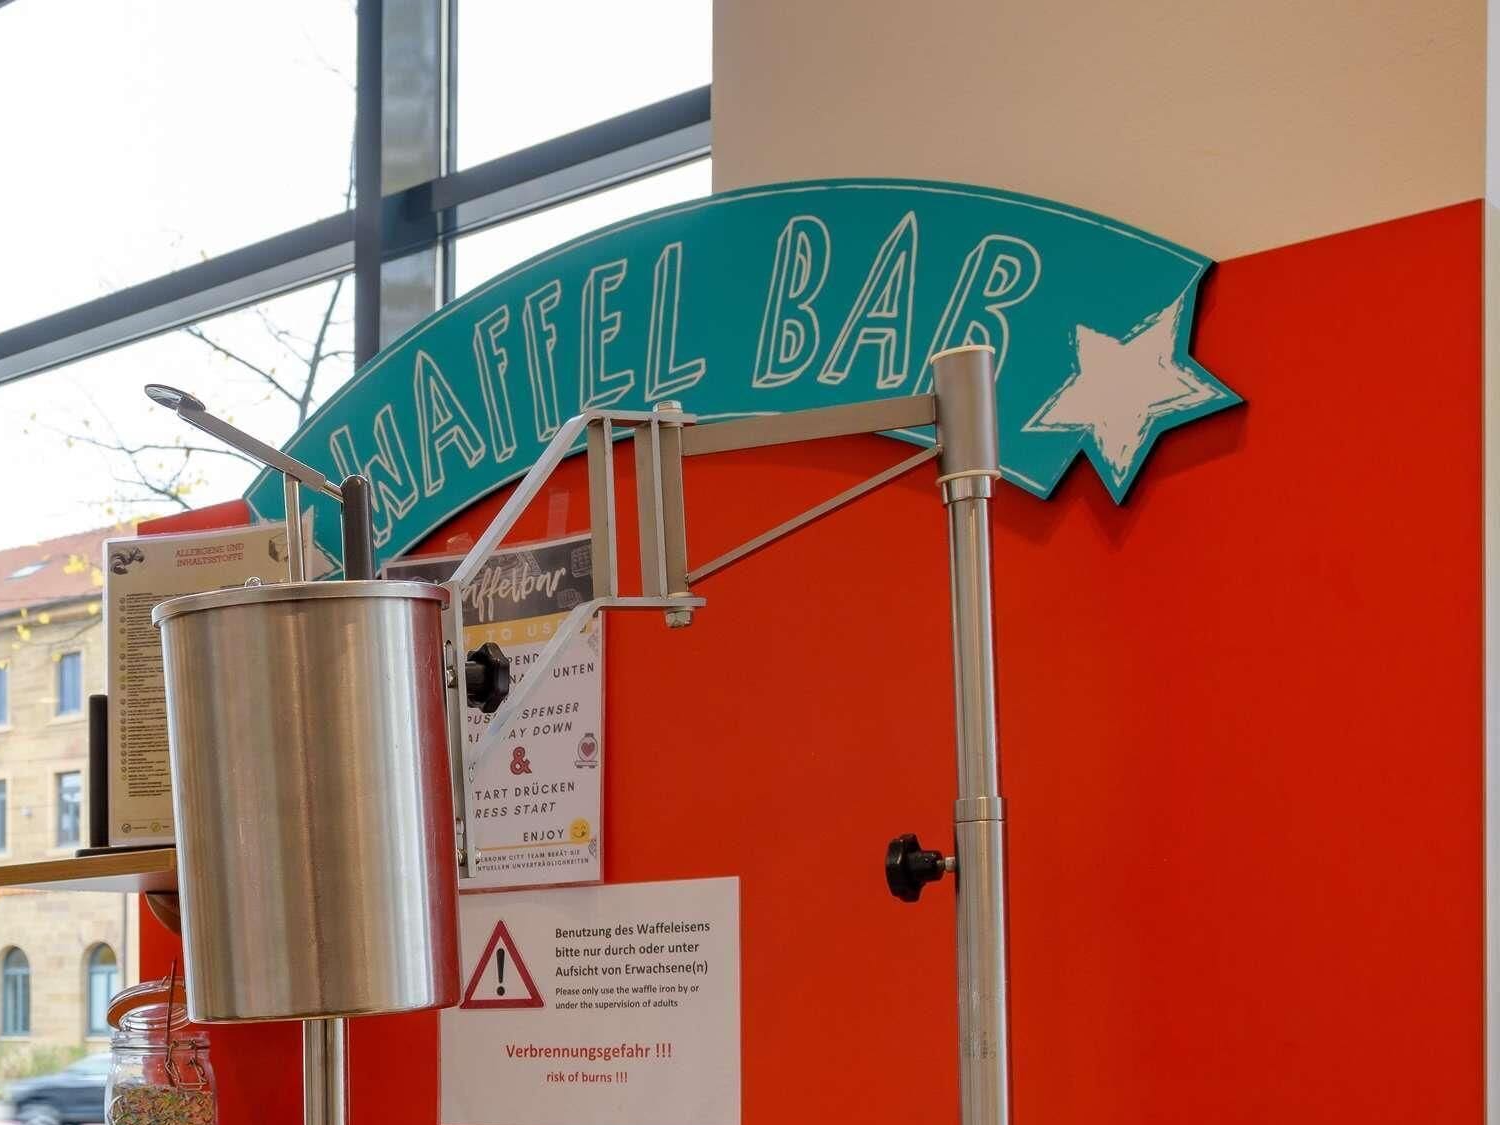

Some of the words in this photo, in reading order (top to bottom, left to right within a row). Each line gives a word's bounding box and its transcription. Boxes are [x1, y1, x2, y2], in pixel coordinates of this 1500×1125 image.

[329, 241, 706, 548] WAFFEL
[752, 210, 1042, 397] BAR
[463, 563, 566, 622] affelbar
[527, 620, 562, 638] US
[553, 662, 594, 678] UNTEN
[521, 702, 579, 720] SPENSER
[508, 728, 527, 740] AY
[533, 721, 572, 736] DOWN
[510, 746, 532, 775] &
[475, 788, 508, 801] TART
[514, 782, 575, 797] DRÜCKEN
[475, 807, 508, 819] RESS
[514, 802, 556, 816] START
[523, 829, 564, 842] ENJOY
[527, 852, 545, 860] TEAM
[555, 927, 612, 939] Benutzung
[615, 924, 634, 936] des
[637, 921, 710, 935] Waffeleisens
[555, 947, 580, 958] bitte
[583, 948, 602, 957] nur
[604, 944, 636, 956] durch
[639, 943, 665, 954] oder
[668, 942, 700, 953] unter
[555, 965, 599, 977] Aufsicht
[601, 966, 622, 976] von
[625, 960, 708, 976] Erwachsene(n)
[555, 987, 580, 996] Please
[581, 986, 599, 997] only
[600, 987, 614, 995] use
[616, 985, 629, 994] the
[631, 984, 657, 994] waffle
[659, 984, 676, 993] iron
[678, 983, 688, 994] by
[690, 985, 700, 993] or
[555, 1001, 578, 1009] under
[579, 1000, 593, 1009] the
[594, 999, 640, 1010] supervision
[642, 999, 651, 1008] of
[652, 999, 678, 1008] adults
[505, 1043, 650, 1061] Verbrennungsgefahr
[655, 1043, 672, 1058] !!!
[546, 1071, 565, 1083] risk
[568, 1071, 579, 1083] of
[581, 1071, 612, 1083] burns
[615, 1071, 628, 1083] !!!
